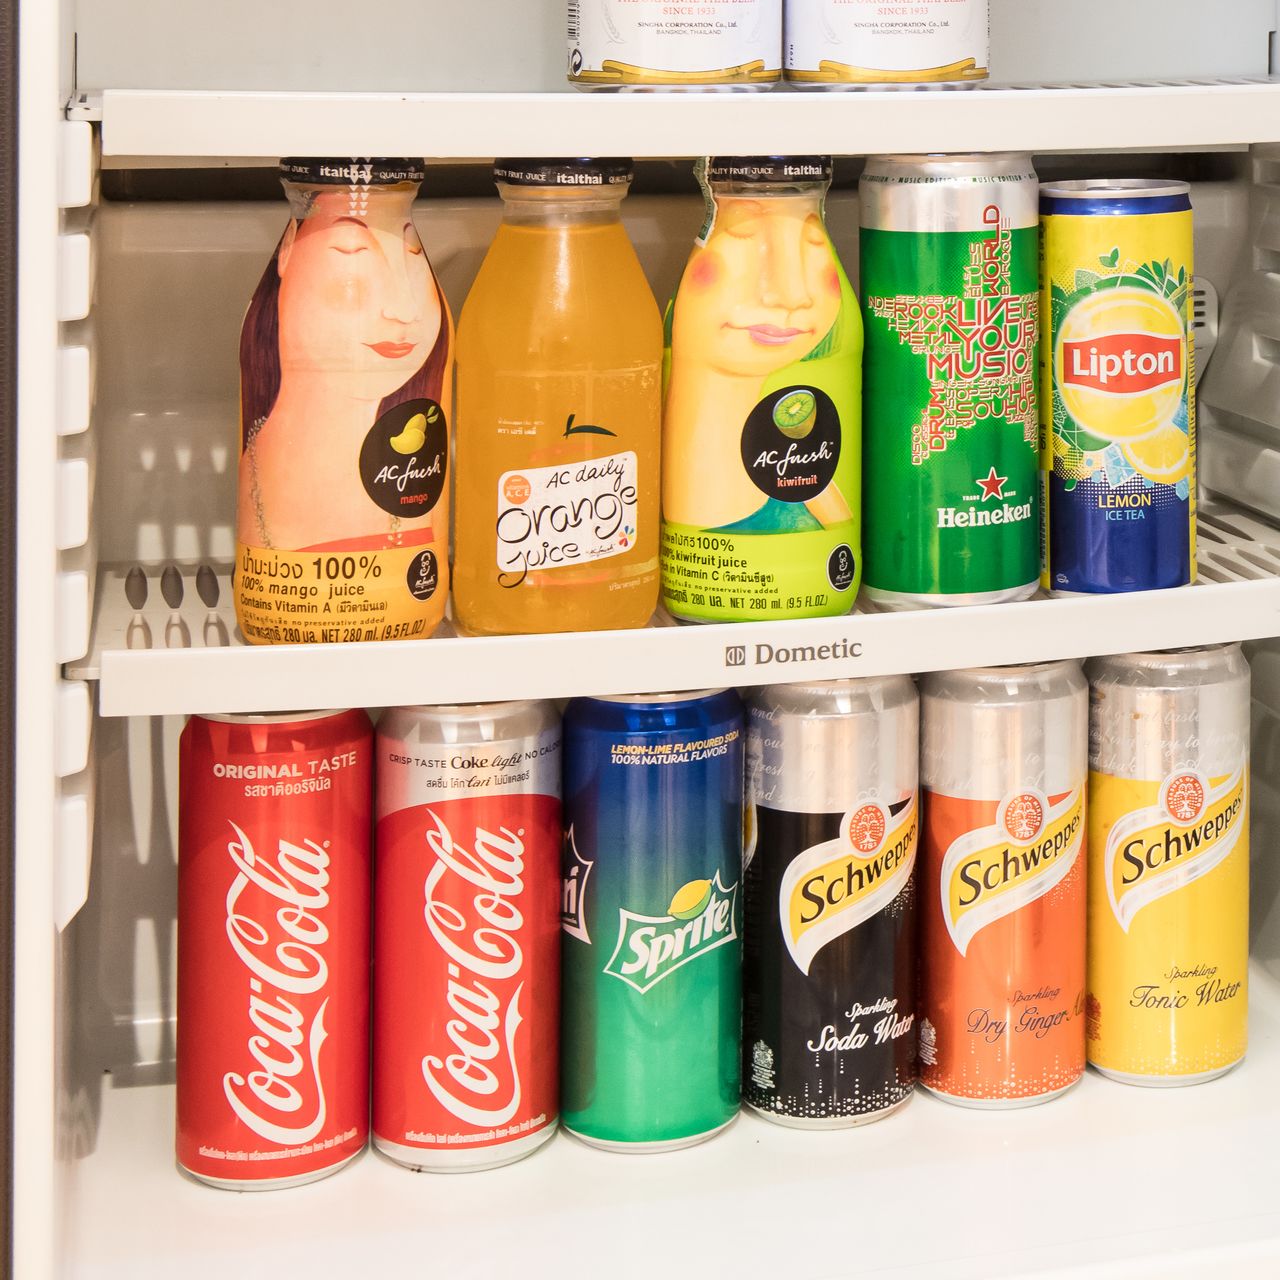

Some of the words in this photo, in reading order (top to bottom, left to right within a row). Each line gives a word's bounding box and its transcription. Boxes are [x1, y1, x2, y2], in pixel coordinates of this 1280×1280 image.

[662, 6, 694, 16] SINCE
[697, 6, 716, 16] 1933
[877, 7, 907, 16] SINCE
[910, 6, 929, 15] 1933
[319, 165, 373, 179] italthai
[379, 171, 407, 180] QUALITY
[525, 172, 547, 182] JUICE
[557, 173, 603, 184] italthai
[729, 167, 749, 175] FRUIT
[751, 167, 774, 175] JUICE
[783, 164, 822, 176] italthai
[898, 176, 921, 184] MUSIC
[982, 204, 1000, 298] WORLD
[1000, 217, 1012, 296] BAROQUE
[969, 242, 983, 298] BLUES
[894, 302, 957, 320] ROCK
[957, 296, 1021, 327] LIVE
[887, 318, 946, 333] HEAVY
[899, 331, 962, 345] METAL
[944, 318, 1036, 361] YOUR
[911, 345, 960, 354] GRUNGE
[927, 348, 1029, 381] MUSIC
[1072, 346, 1174, 384] Lipton
[929, 387, 947, 451] DRUM
[911, 424, 922, 465] DISCO
[753, 450, 779, 468] AC
[374, 465, 399, 484] AC
[546, 471, 571, 489] AC
[575, 458, 625, 493] daily
[776, 475, 818, 488] kiwifruit
[400, 493, 429, 505] mango
[1098, 493, 1152, 508] LEMON
[937, 503, 1031, 528] Heineken
[1105, 510, 1122, 521] ICE
[1124, 509, 1145, 520] TEA
[697, 536, 735, 552] 100%
[242, 548, 304, 579] น้ำมะม่วง
[312, 554, 382, 580] 100%
[497, 541, 581, 588] juice
[675, 550, 716, 566] kiwifruit
[717, 556, 748, 569] juice
[669, 563, 676, 573] in
[676, 566, 708, 581] Vitamin
[711, 571, 720, 581] C
[241, 575, 264, 593] 100%
[269, 582, 318, 599] mango
[328, 583, 365, 600] juice
[704, 585, 752, 594] preservative
[240, 593, 272, 611] Contains
[274, 599, 318, 614] Vitamin
[322, 601, 332, 613] A
[691, 593, 705, 606] 280
[730, 597, 745, 609] NET
[749, 598, 767, 610] 280
[771, 597, 783, 610] ml.
[786, 596, 802, 610] (9.5
[304, 619, 358, 627] preservative
[360, 616, 385, 625] added
[282, 627, 301, 643] 280
[321, 629, 341, 643] NET
[343, 628, 362, 642] 280
[364, 625, 379, 641] ml.
[381, 623, 400, 641] (9.5
[755, 638, 863, 665] Dometic
[611, 744, 673, 755] LEMON-LIME
[673, 735, 724, 754] FLAVOURED
[611, 754, 641, 766] 100%
[641, 751, 690, 765] NATURAL
[690, 744, 728, 762] FLAVORS
[213, 763, 303, 779] ORIGINAL
[307, 751, 357, 775] TASTE
[389, 753, 413, 764] CRISP
[414, 759, 447, 769] TASTE
[451, 755, 489, 770] Coke
[490, 752, 523, 771] light
[524, 750, 538, 761] NO
[244, 776, 332, 797] รสชาติออริจินัล
[1177, 811, 1196, 819] 1783
[1015, 831, 1034, 839] 1783
[1122, 791, 1242, 885] Schweppes
[860, 842, 878, 850] 1783
[959, 814, 1081, 907] Schweppes
[620, 891, 730, 980] Sprite
[421, 807, 527, 1128] Coca-Cola
[1164, 963, 1218, 984] Sparkling
[222, 818, 331, 1146] Coca-Cola
[1007, 985, 1061, 1008] Sparkling
[1129, 984, 1190, 1009] Tonic
[1195, 978, 1241, 1007] Water
[844, 996, 899, 1023] Sparkling
[966, 1007, 1009, 1044] Dry
[1014, 1005, 1070, 1040] Ginger
[806, 1022, 870, 1053] Soda
